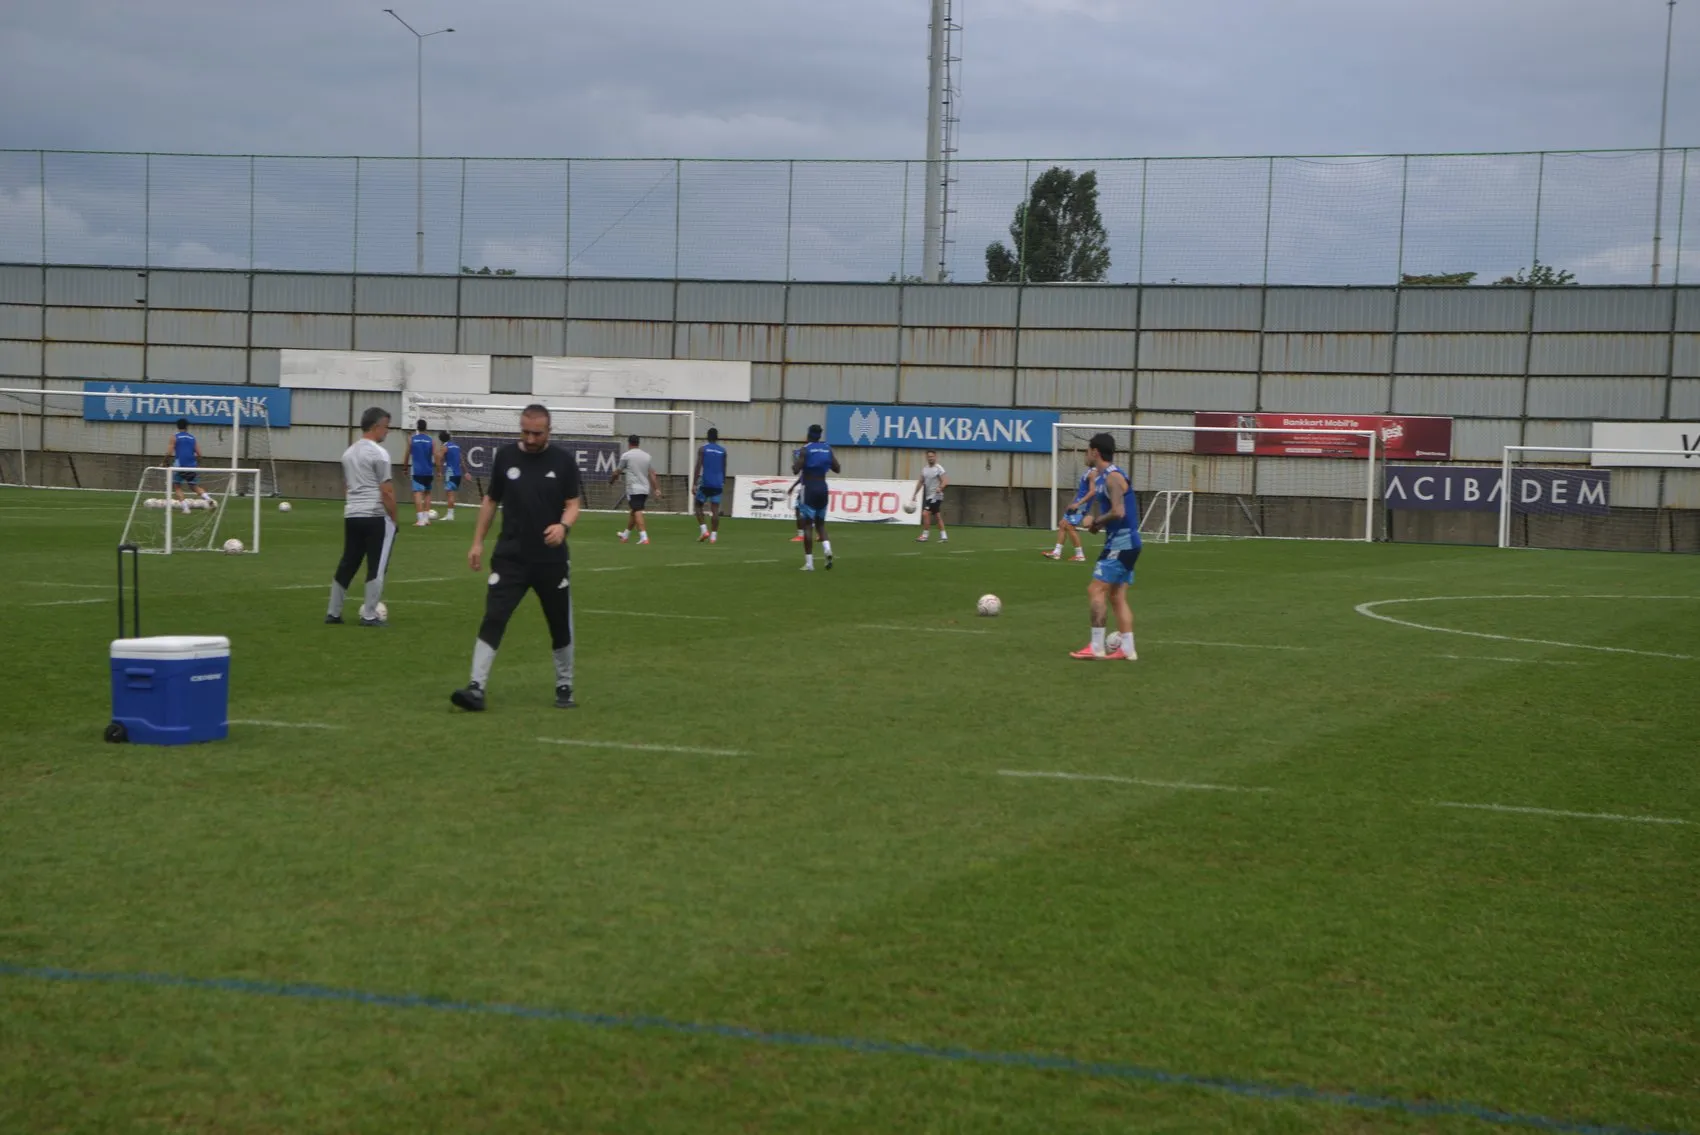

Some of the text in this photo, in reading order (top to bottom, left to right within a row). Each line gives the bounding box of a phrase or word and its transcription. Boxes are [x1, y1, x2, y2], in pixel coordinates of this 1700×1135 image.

[136, 393, 268, 418] HALKBANK
[884, 415, 1033, 443] HALKBANK
[828, 490, 899, 515] TOTO
